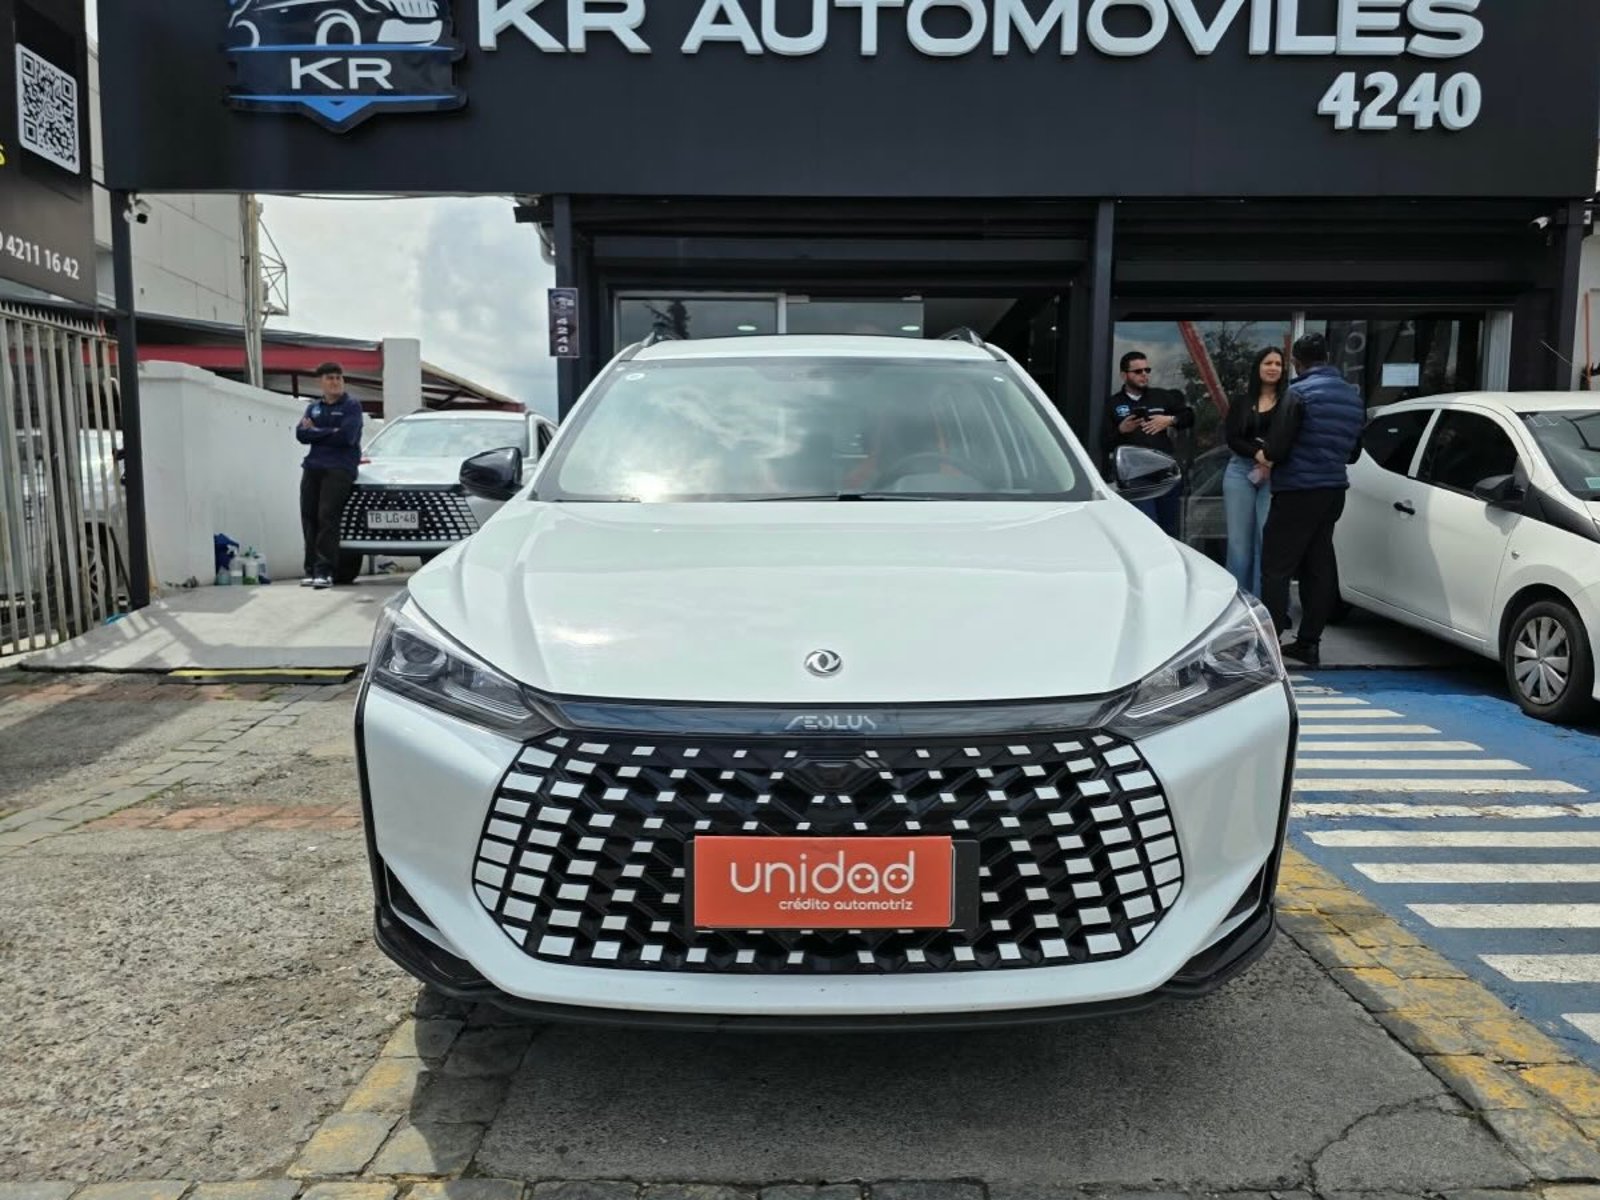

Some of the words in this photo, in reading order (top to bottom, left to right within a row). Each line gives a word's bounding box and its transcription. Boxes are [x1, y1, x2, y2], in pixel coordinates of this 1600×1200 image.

[478, 0, 651, 53] KR
[680, 0, 1484, 58] AUTOMOVILES
[290, 57, 394, 90] KR
[1317, 71, 1482, 130] 4240
[6, 234, 40, 265] 4211
[44, 248, 61, 273] 16
[63, 256, 80, 281] 42
[730, 850, 915, 894] unidad
[778, 898, 830, 911] crédito
[833, 899, 913, 911] automotriz
